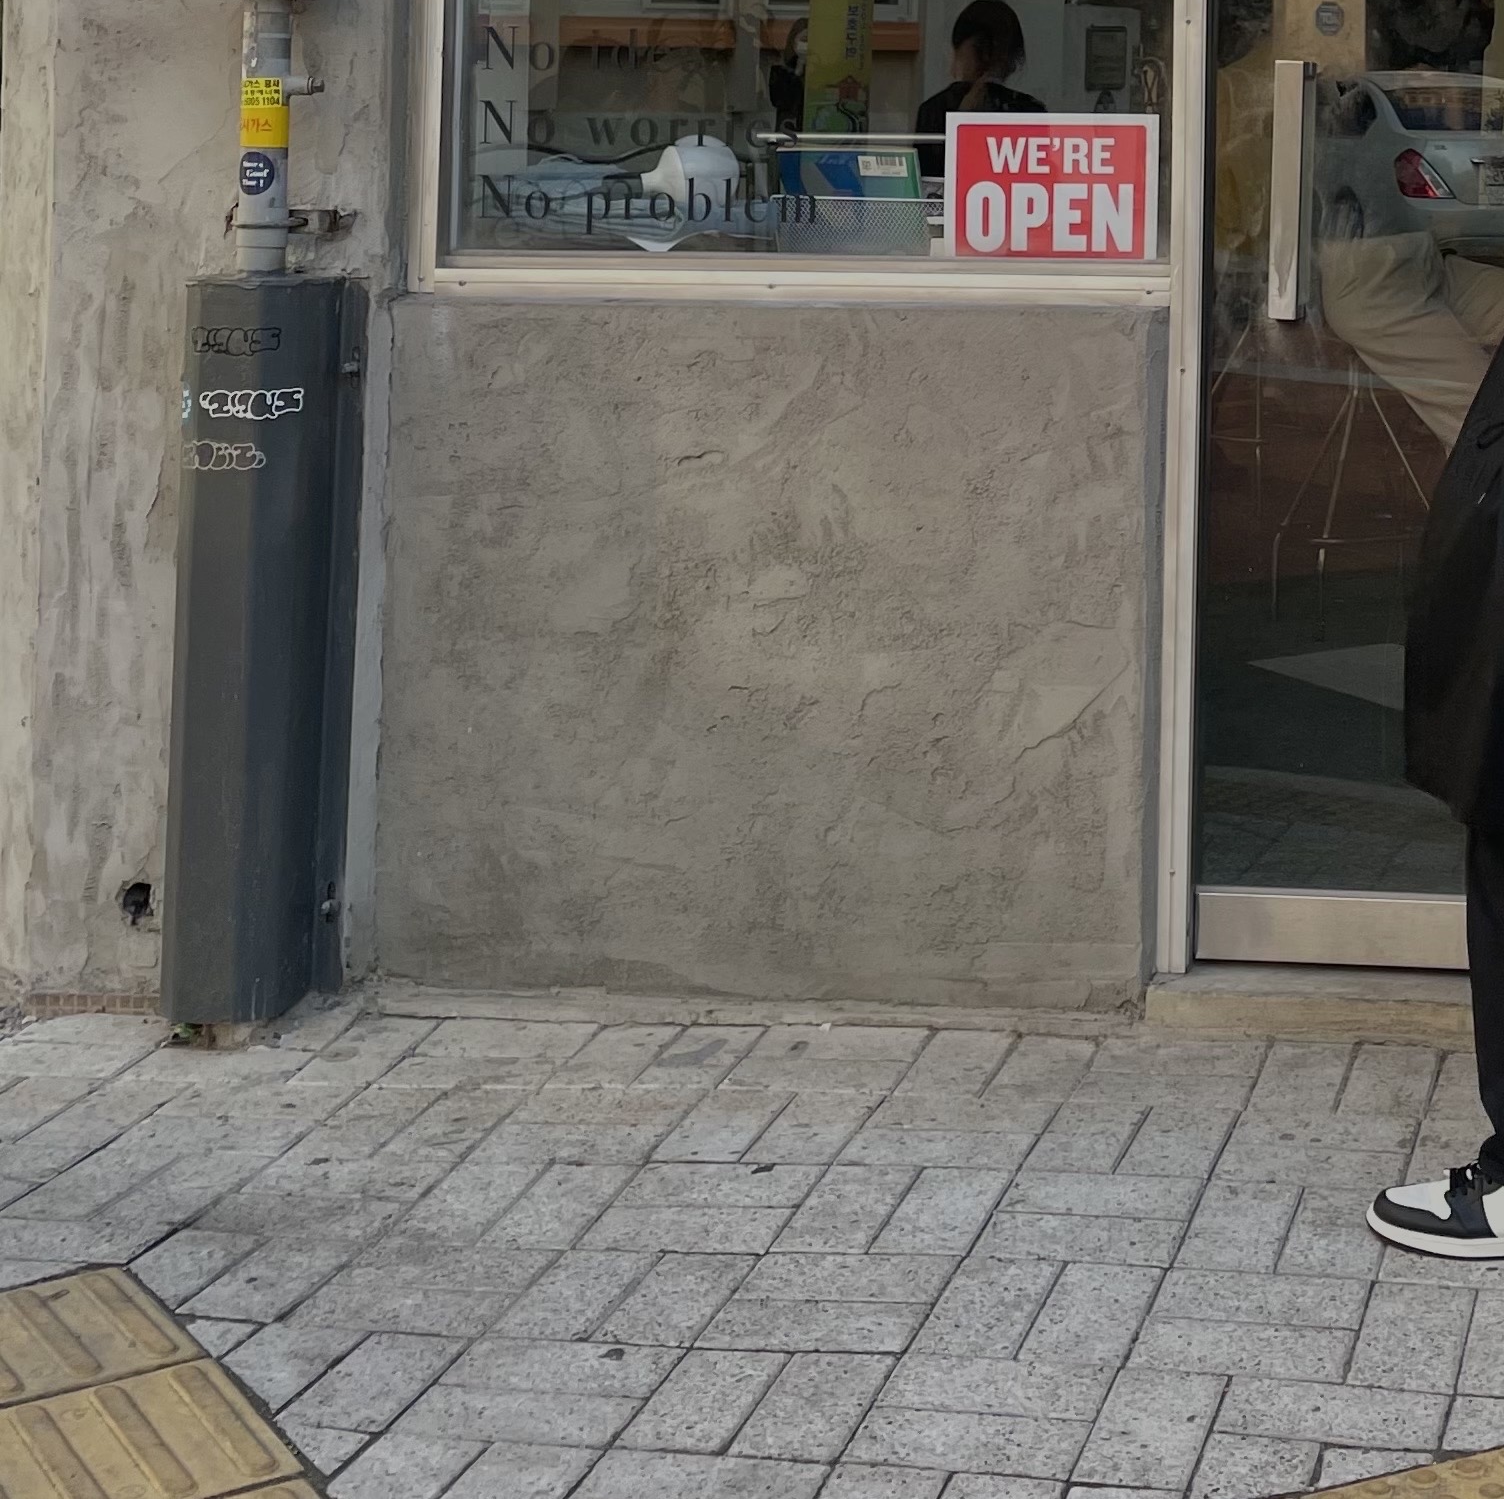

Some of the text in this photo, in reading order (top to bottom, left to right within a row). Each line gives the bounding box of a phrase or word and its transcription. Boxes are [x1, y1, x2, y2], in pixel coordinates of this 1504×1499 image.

[482, 25, 704, 73] No ide
[241, 117, 272, 132] 시가스
[480, 100, 799, 148] No worries
[986, 136, 1116, 174] WE'RE
[479, 175, 818, 235] No problem
[964, 183, 1134, 253] OPEN
